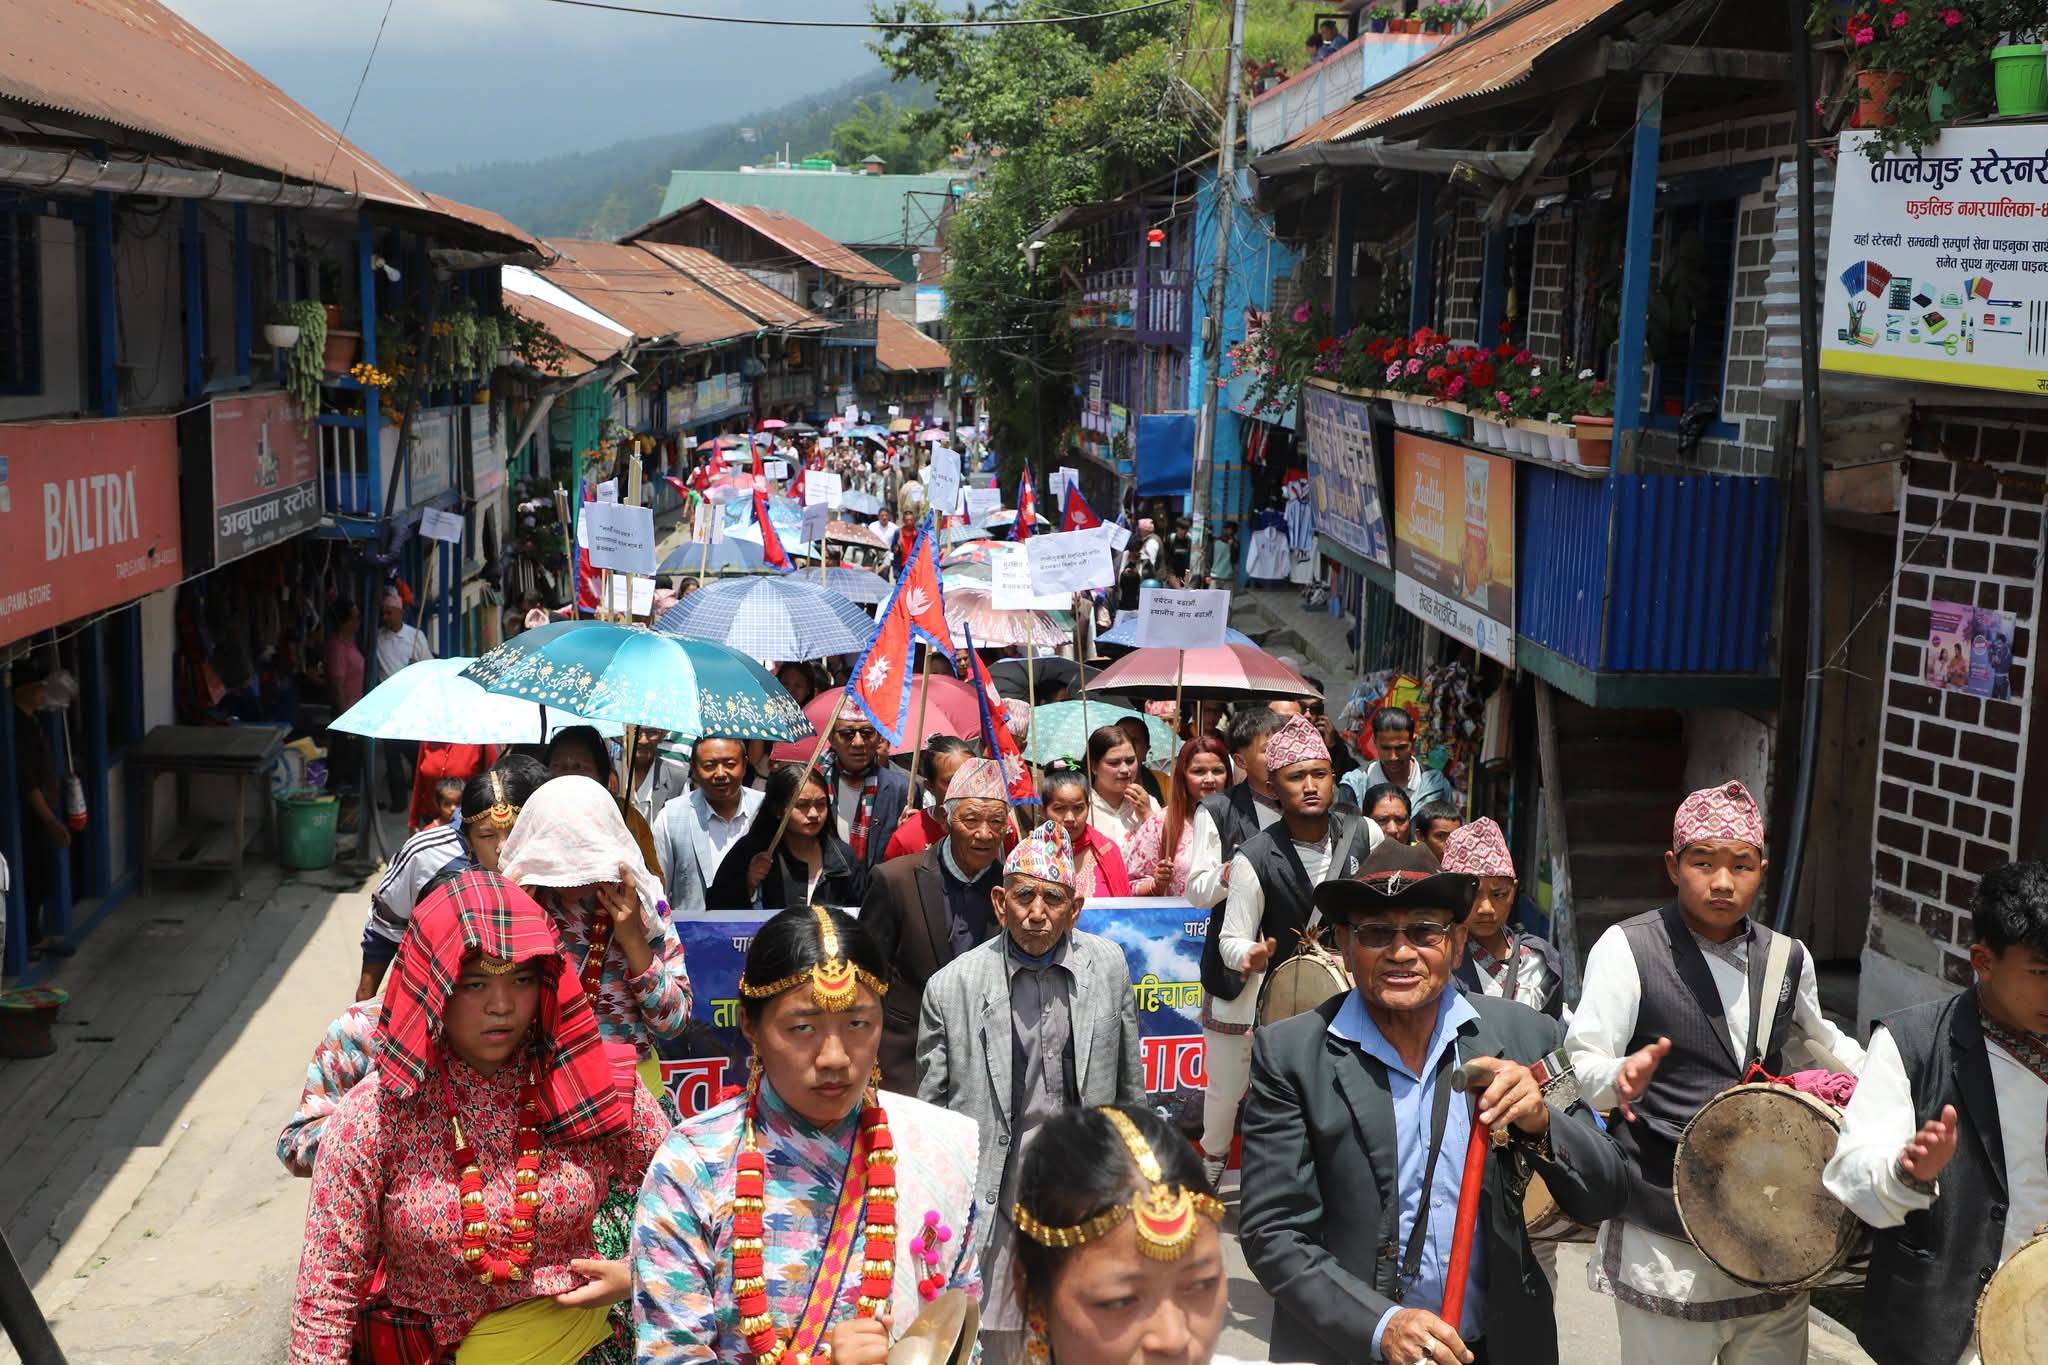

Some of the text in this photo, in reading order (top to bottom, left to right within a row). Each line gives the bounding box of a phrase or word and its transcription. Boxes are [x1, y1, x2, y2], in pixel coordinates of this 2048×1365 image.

[1970, 148, 2048, 185] स्टेस्नर
[1936, 254, 1957, 269] समेत
[1973, 236, 1990, 251] सेवा
[1414, 471, 1445, 521] Healthy
[43, 469, 139, 561] BALTRA
[220, 499, 281, 537] अनुपमा
